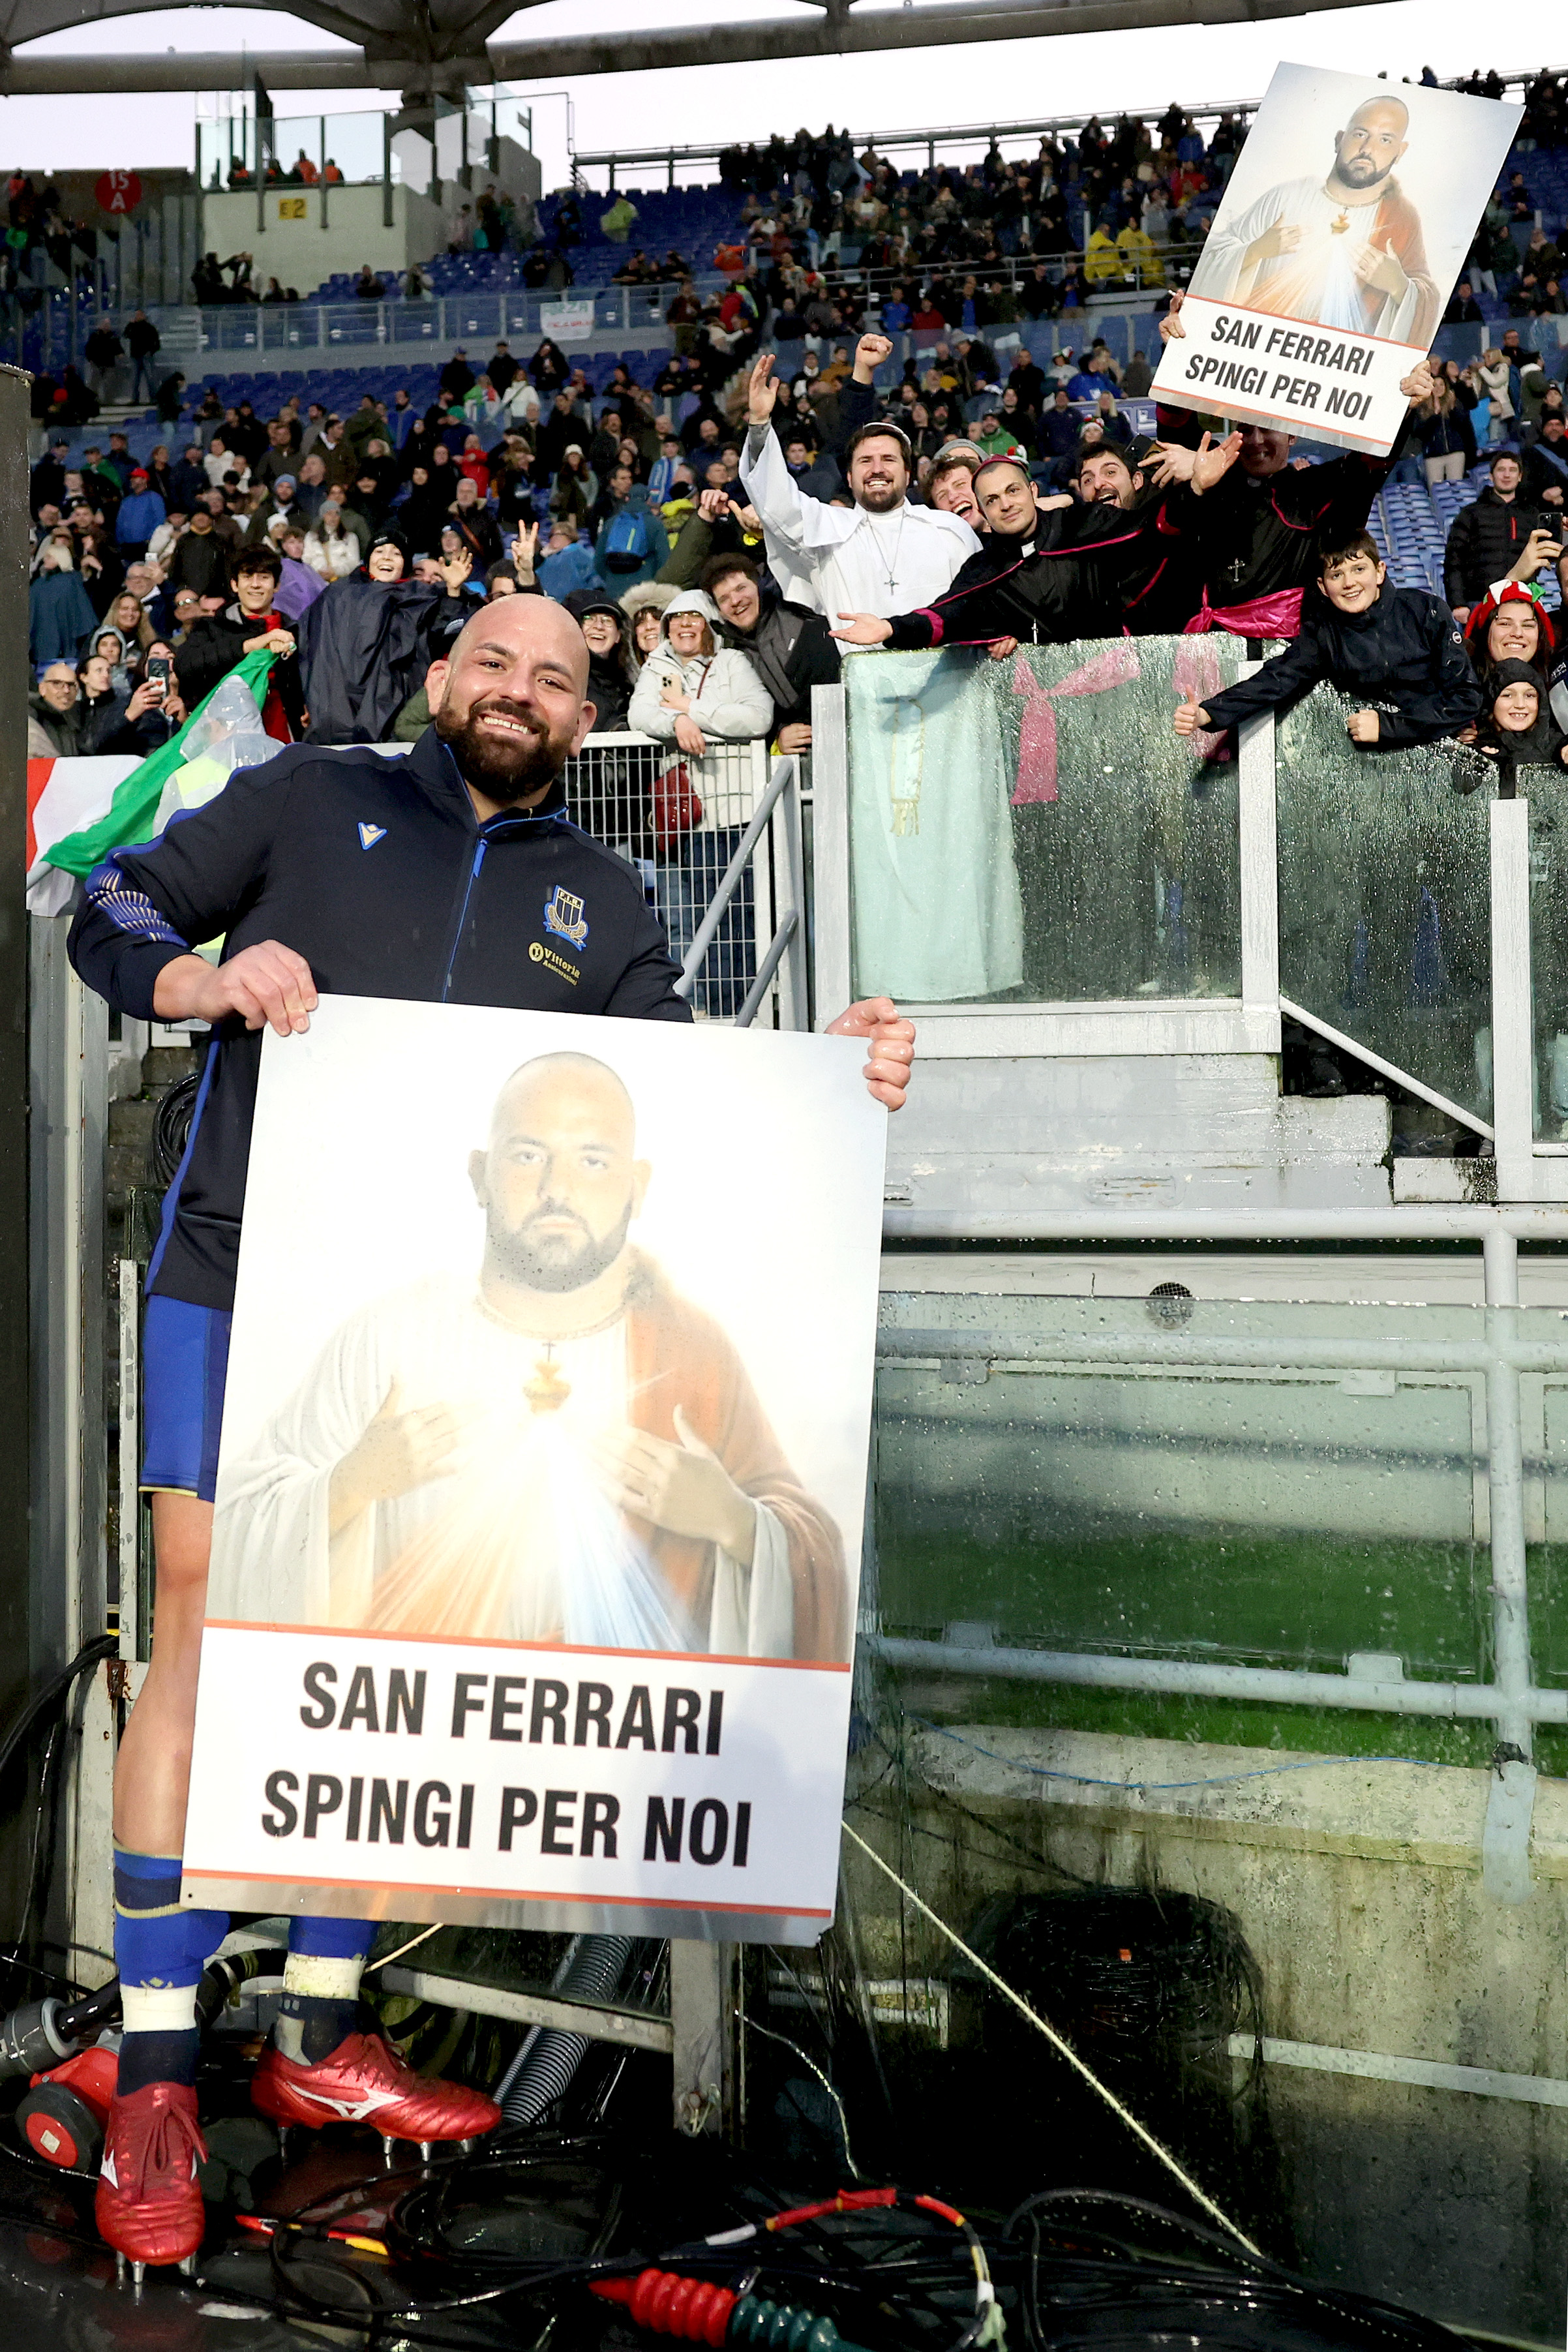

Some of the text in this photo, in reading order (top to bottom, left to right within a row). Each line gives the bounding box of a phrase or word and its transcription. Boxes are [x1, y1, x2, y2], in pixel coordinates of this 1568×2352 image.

[108, 168, 131, 190] 15
[110, 192, 126, 209] A
[294, 198, 304, 218] 2
[1211, 316, 1375, 376] SAN FERRARI
[1185, 354, 1372, 421] SPINGI PER NOI
[560, 891, 580, 907] F.I.R.
[544, 947, 580, 978] Vittoria
[299, 1661, 724, 1756] SAN FERRARI
[262, 1770, 752, 1868] SPINGI PER NOI
